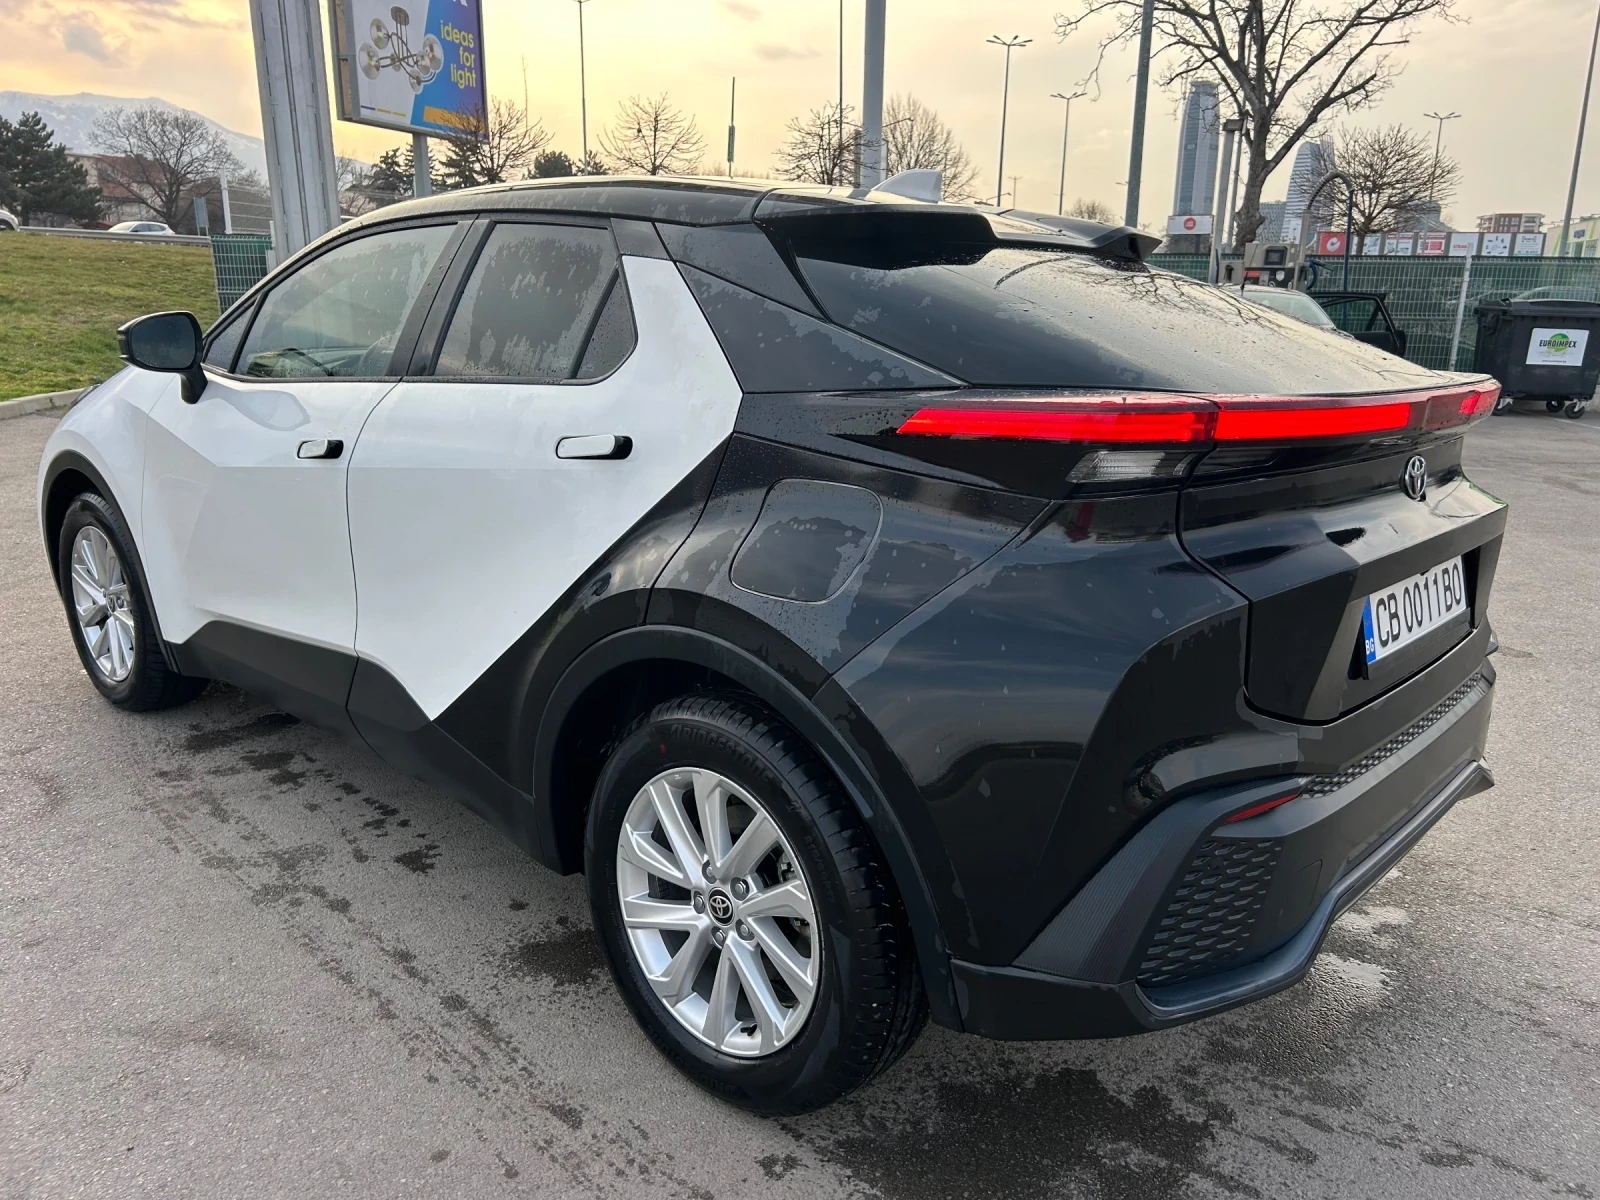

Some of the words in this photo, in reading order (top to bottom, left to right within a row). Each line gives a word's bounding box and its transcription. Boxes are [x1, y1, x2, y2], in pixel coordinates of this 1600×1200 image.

[440, 20, 475, 48] ideas
[460, 48, 475, 68] for
[451, 63, 476, 89] light
[1539, 340, 1577, 349] EUROIMPEX
[1376, 592, 1401, 648] CB
[1402, 571, 1441, 634] 0011
[1441, 562, 1462, 613] BO
[1365, 638, 1374, 655] BG
[669, 724, 774, 783] BRIDGESTONE
